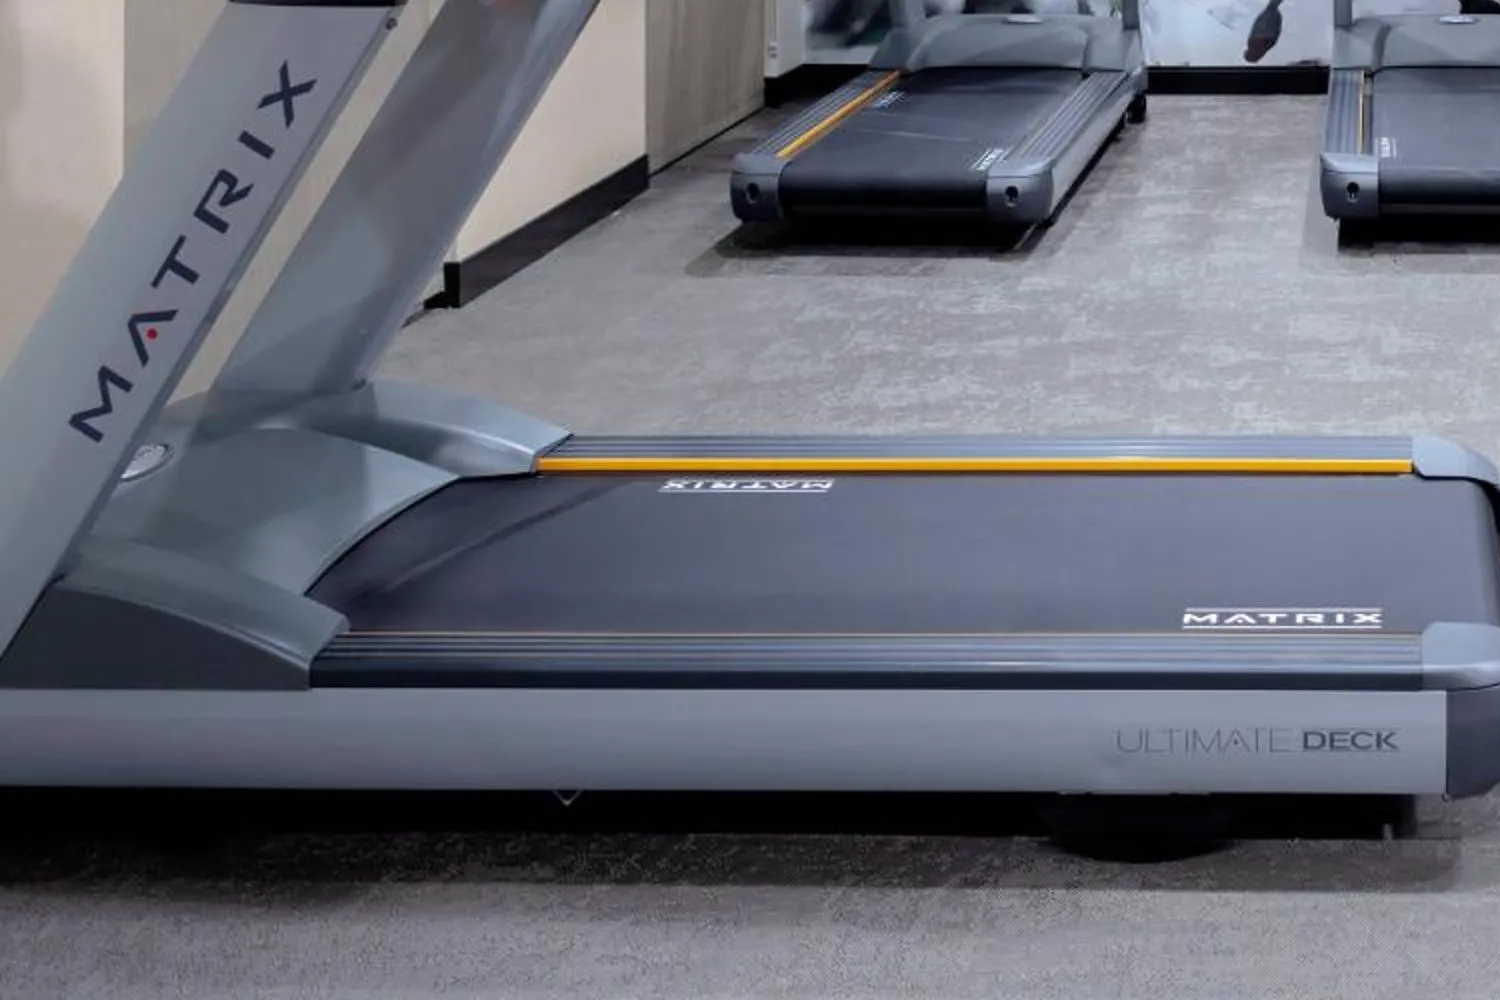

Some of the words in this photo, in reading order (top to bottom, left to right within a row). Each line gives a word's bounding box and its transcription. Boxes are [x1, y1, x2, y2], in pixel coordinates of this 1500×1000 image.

[69, 60, 317, 443] MATRIX
[1183, 611, 1382, 626] MATRIX
[1115, 728, 1293, 753] ULTIMATE
[1302, 730, 1399, 751] DECK
